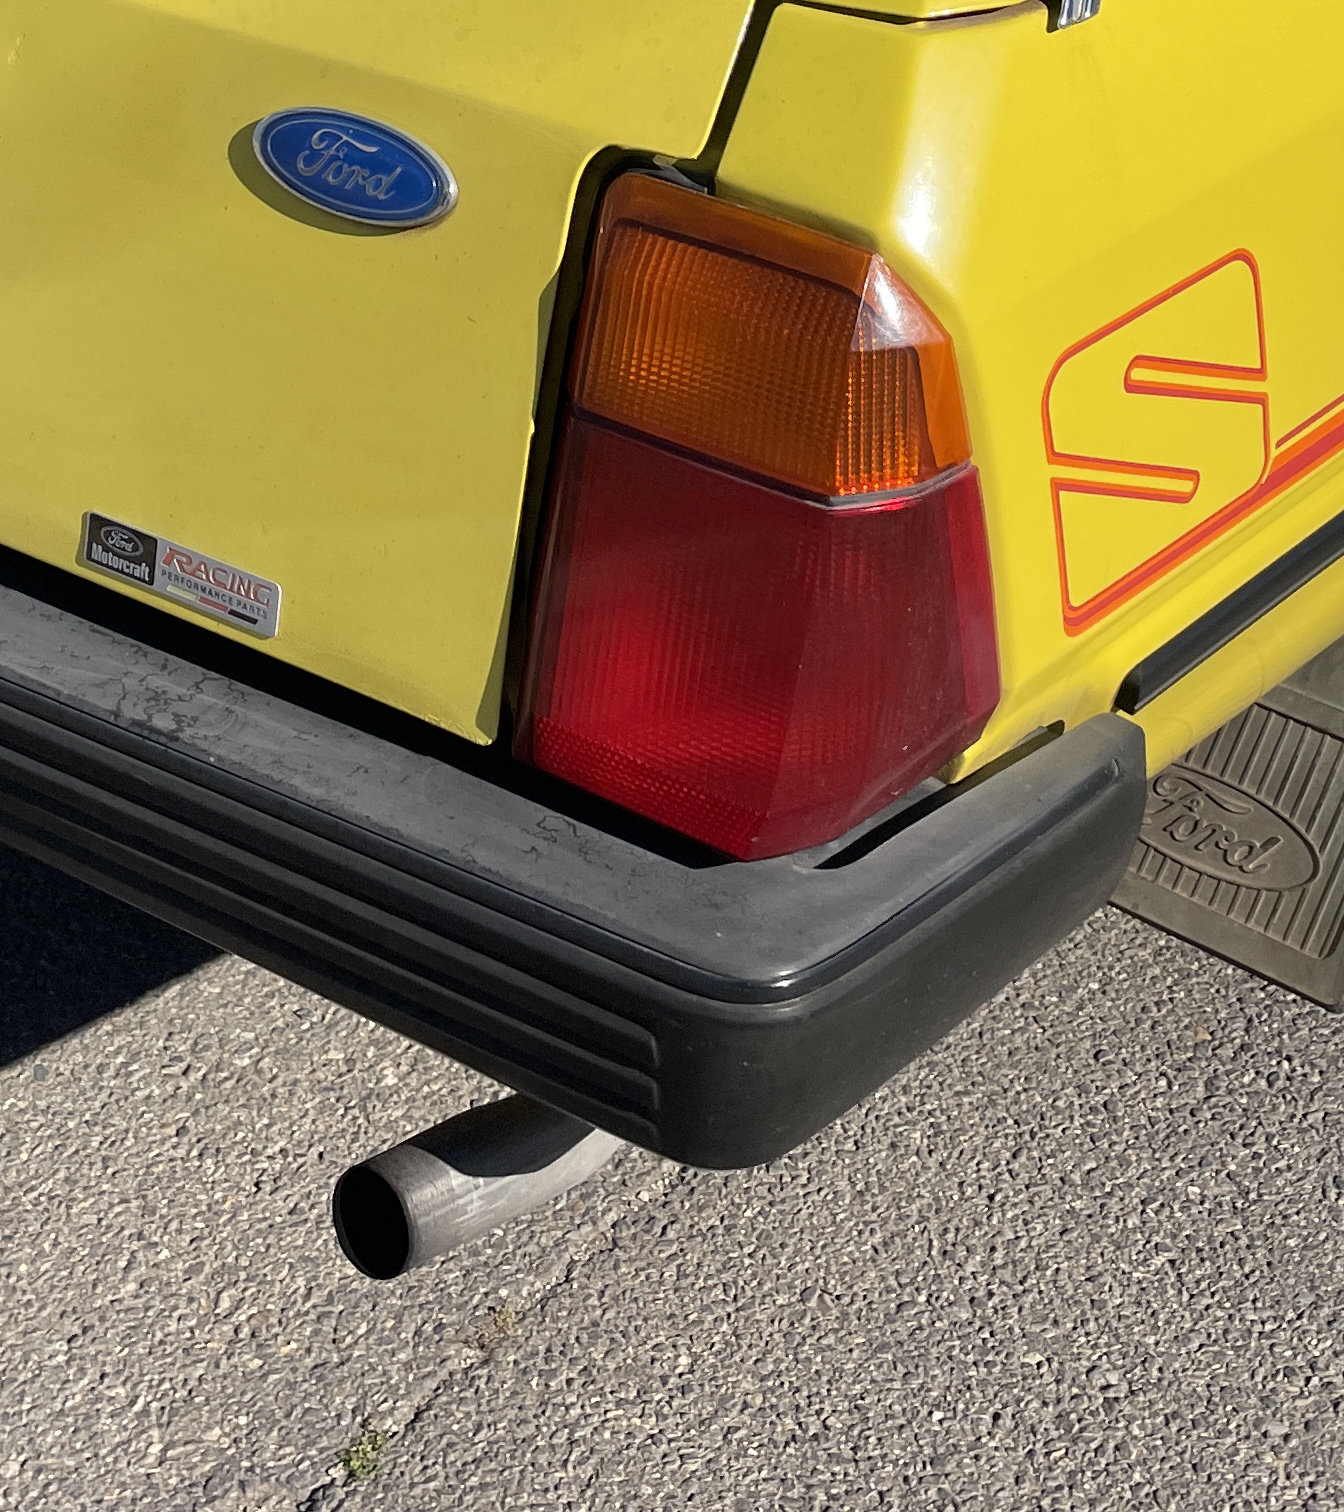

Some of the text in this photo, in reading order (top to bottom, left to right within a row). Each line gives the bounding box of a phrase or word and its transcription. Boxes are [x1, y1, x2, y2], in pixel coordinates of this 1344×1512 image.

[296, 127, 402, 201] Ford
[90, 542, 150, 582] Motorcraft
[107, 529, 134, 553] Ford
[161, 546, 273, 608] RACING
[161, 569, 268, 620] PERFORMANCE PARTS
[1144, 773, 1284, 874] Ford
